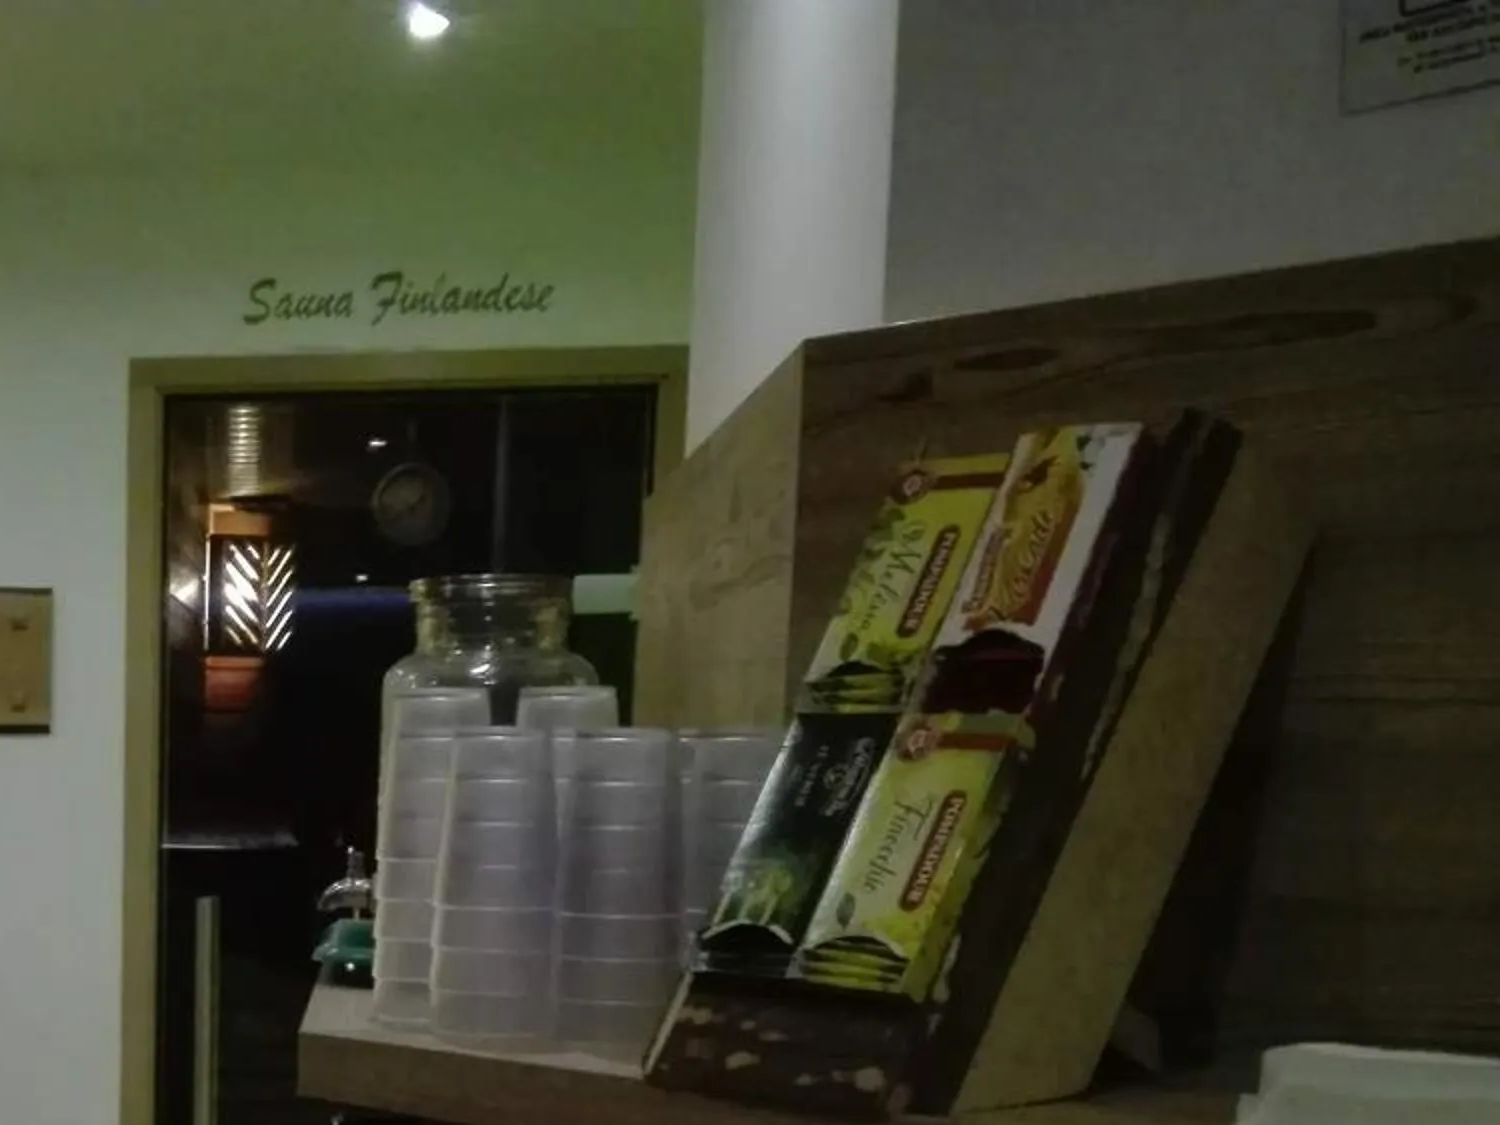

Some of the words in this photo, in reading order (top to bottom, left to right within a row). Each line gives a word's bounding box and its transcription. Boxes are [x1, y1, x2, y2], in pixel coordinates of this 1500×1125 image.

[243, 277, 353, 326] Sauna
[370, 270, 555, 327] Finlandese
[906, 796, 966, 904] POMPADOUR
